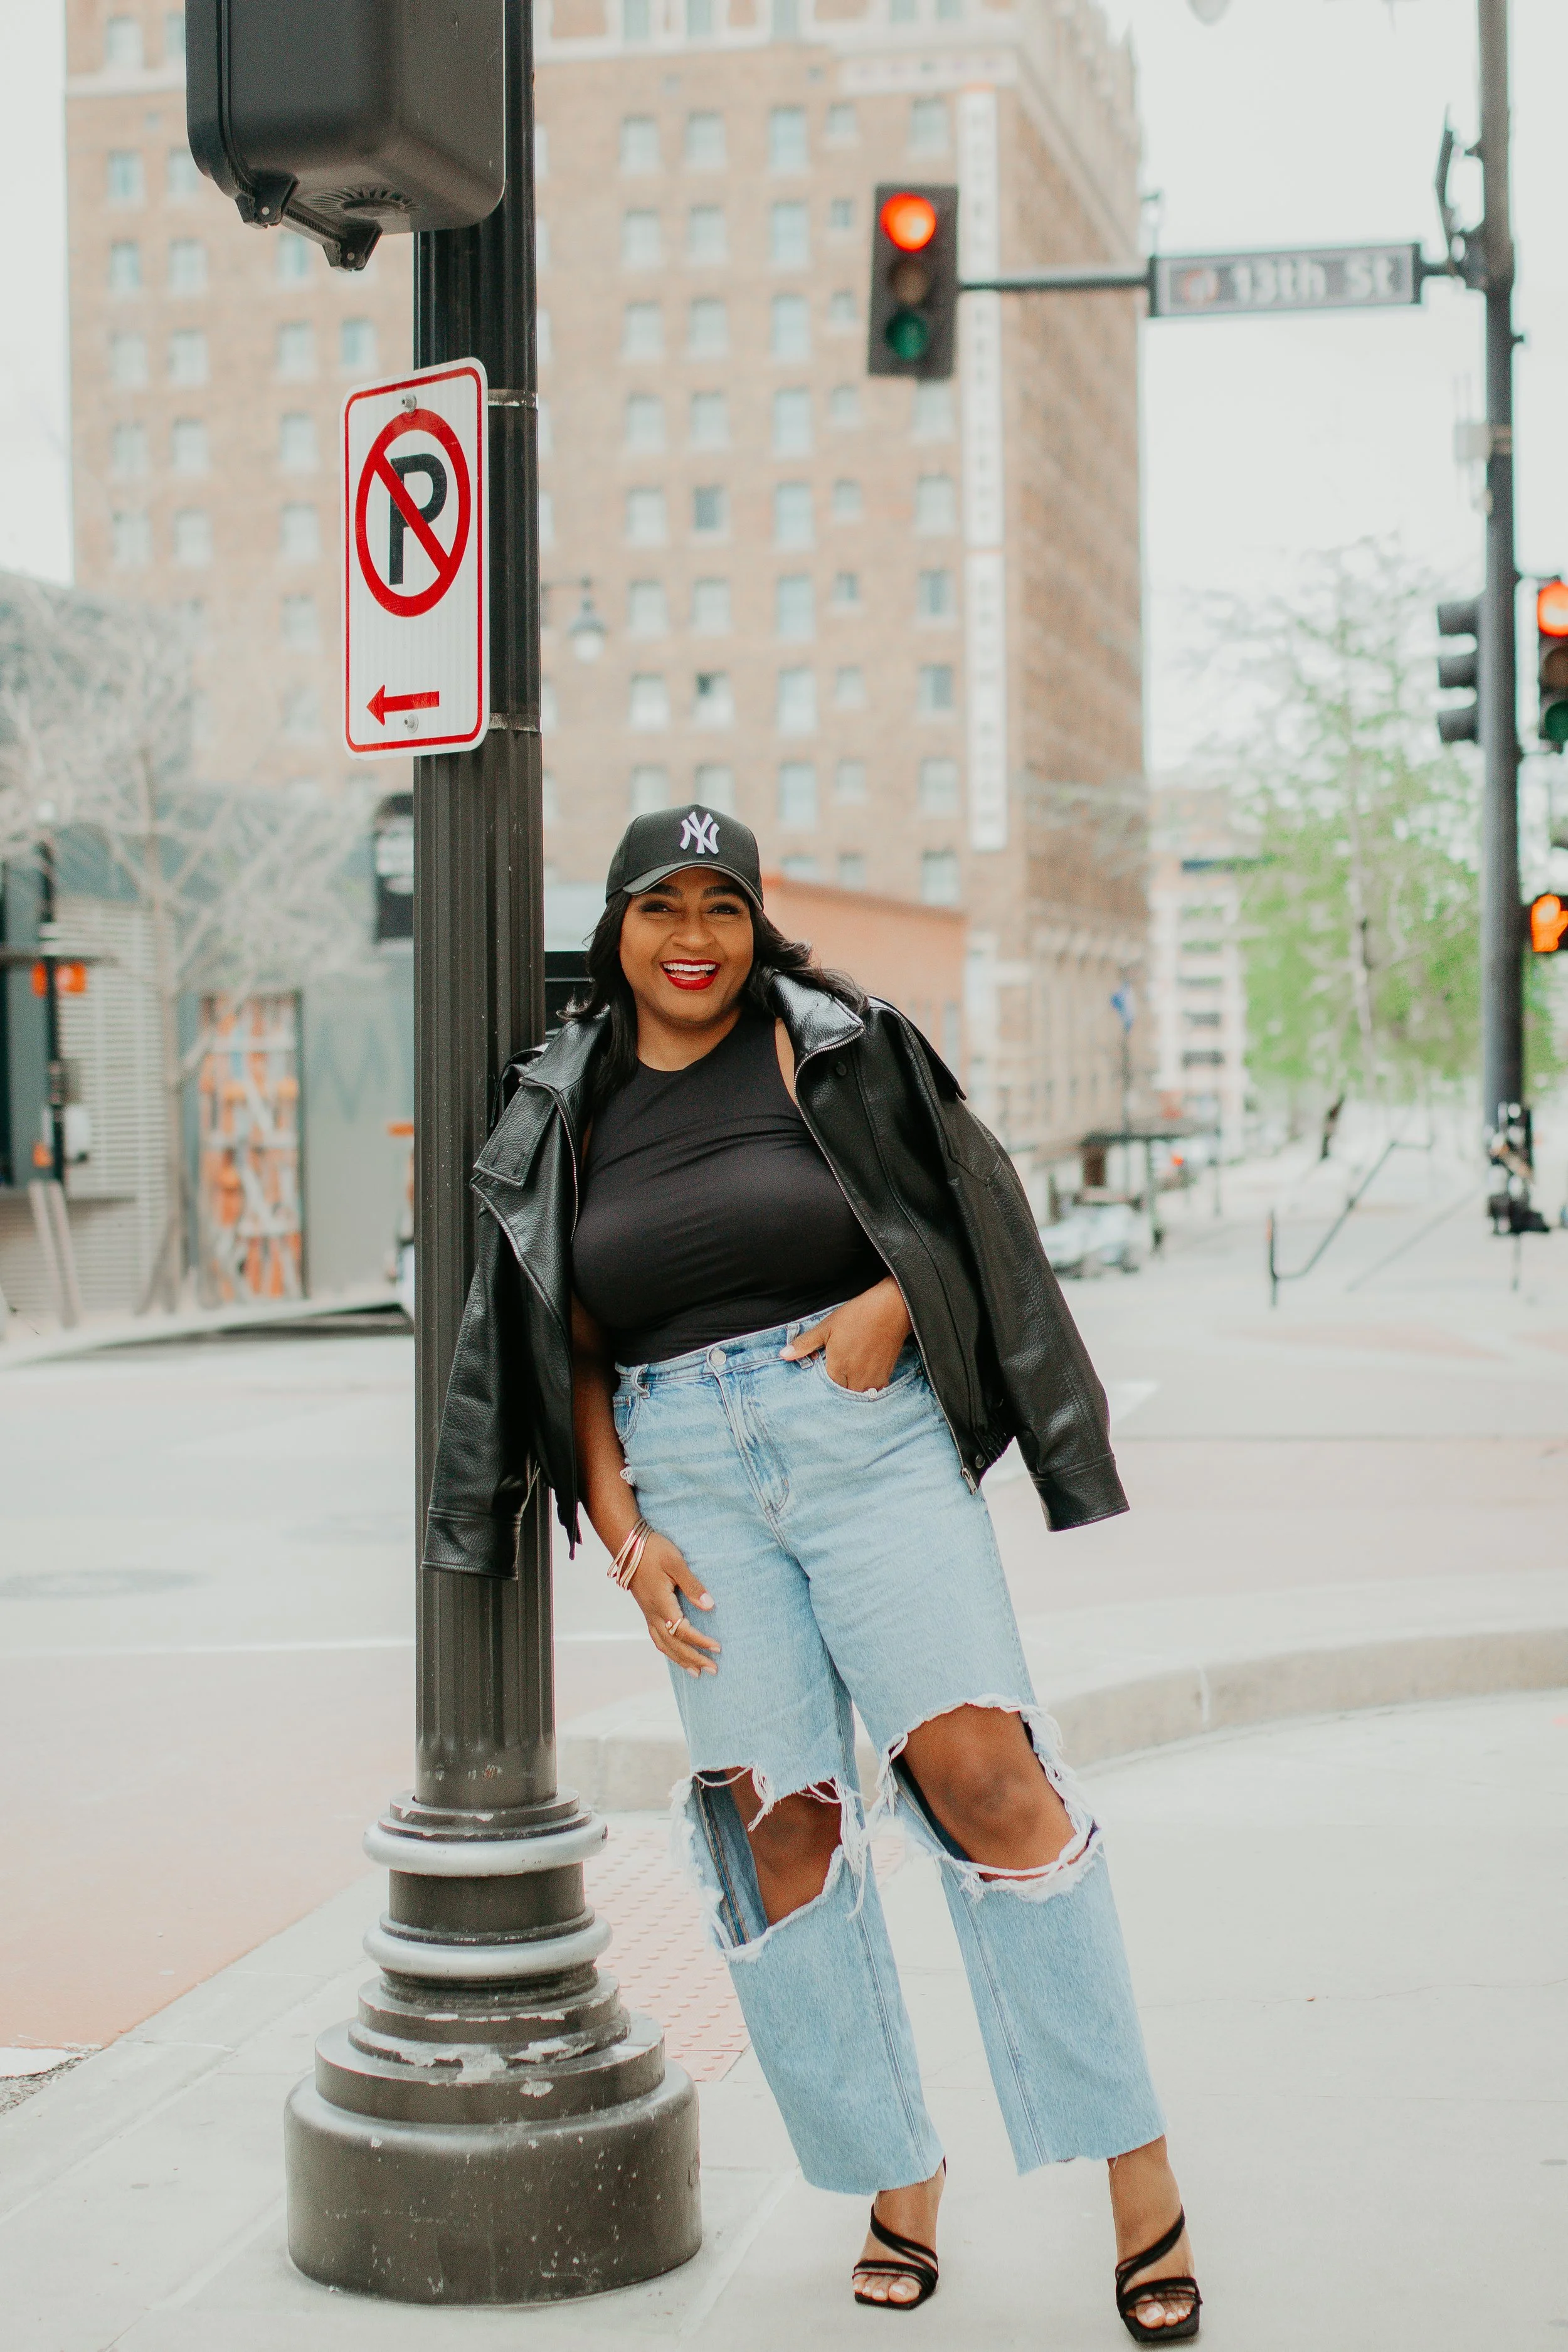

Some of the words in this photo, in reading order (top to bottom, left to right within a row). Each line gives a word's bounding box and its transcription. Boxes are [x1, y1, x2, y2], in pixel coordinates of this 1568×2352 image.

[1232, 255, 1327, 306] 13th
[1345, 252, 1393, 300] St
[389, 453, 448, 585] P
[680, 812, 720, 854] NY
